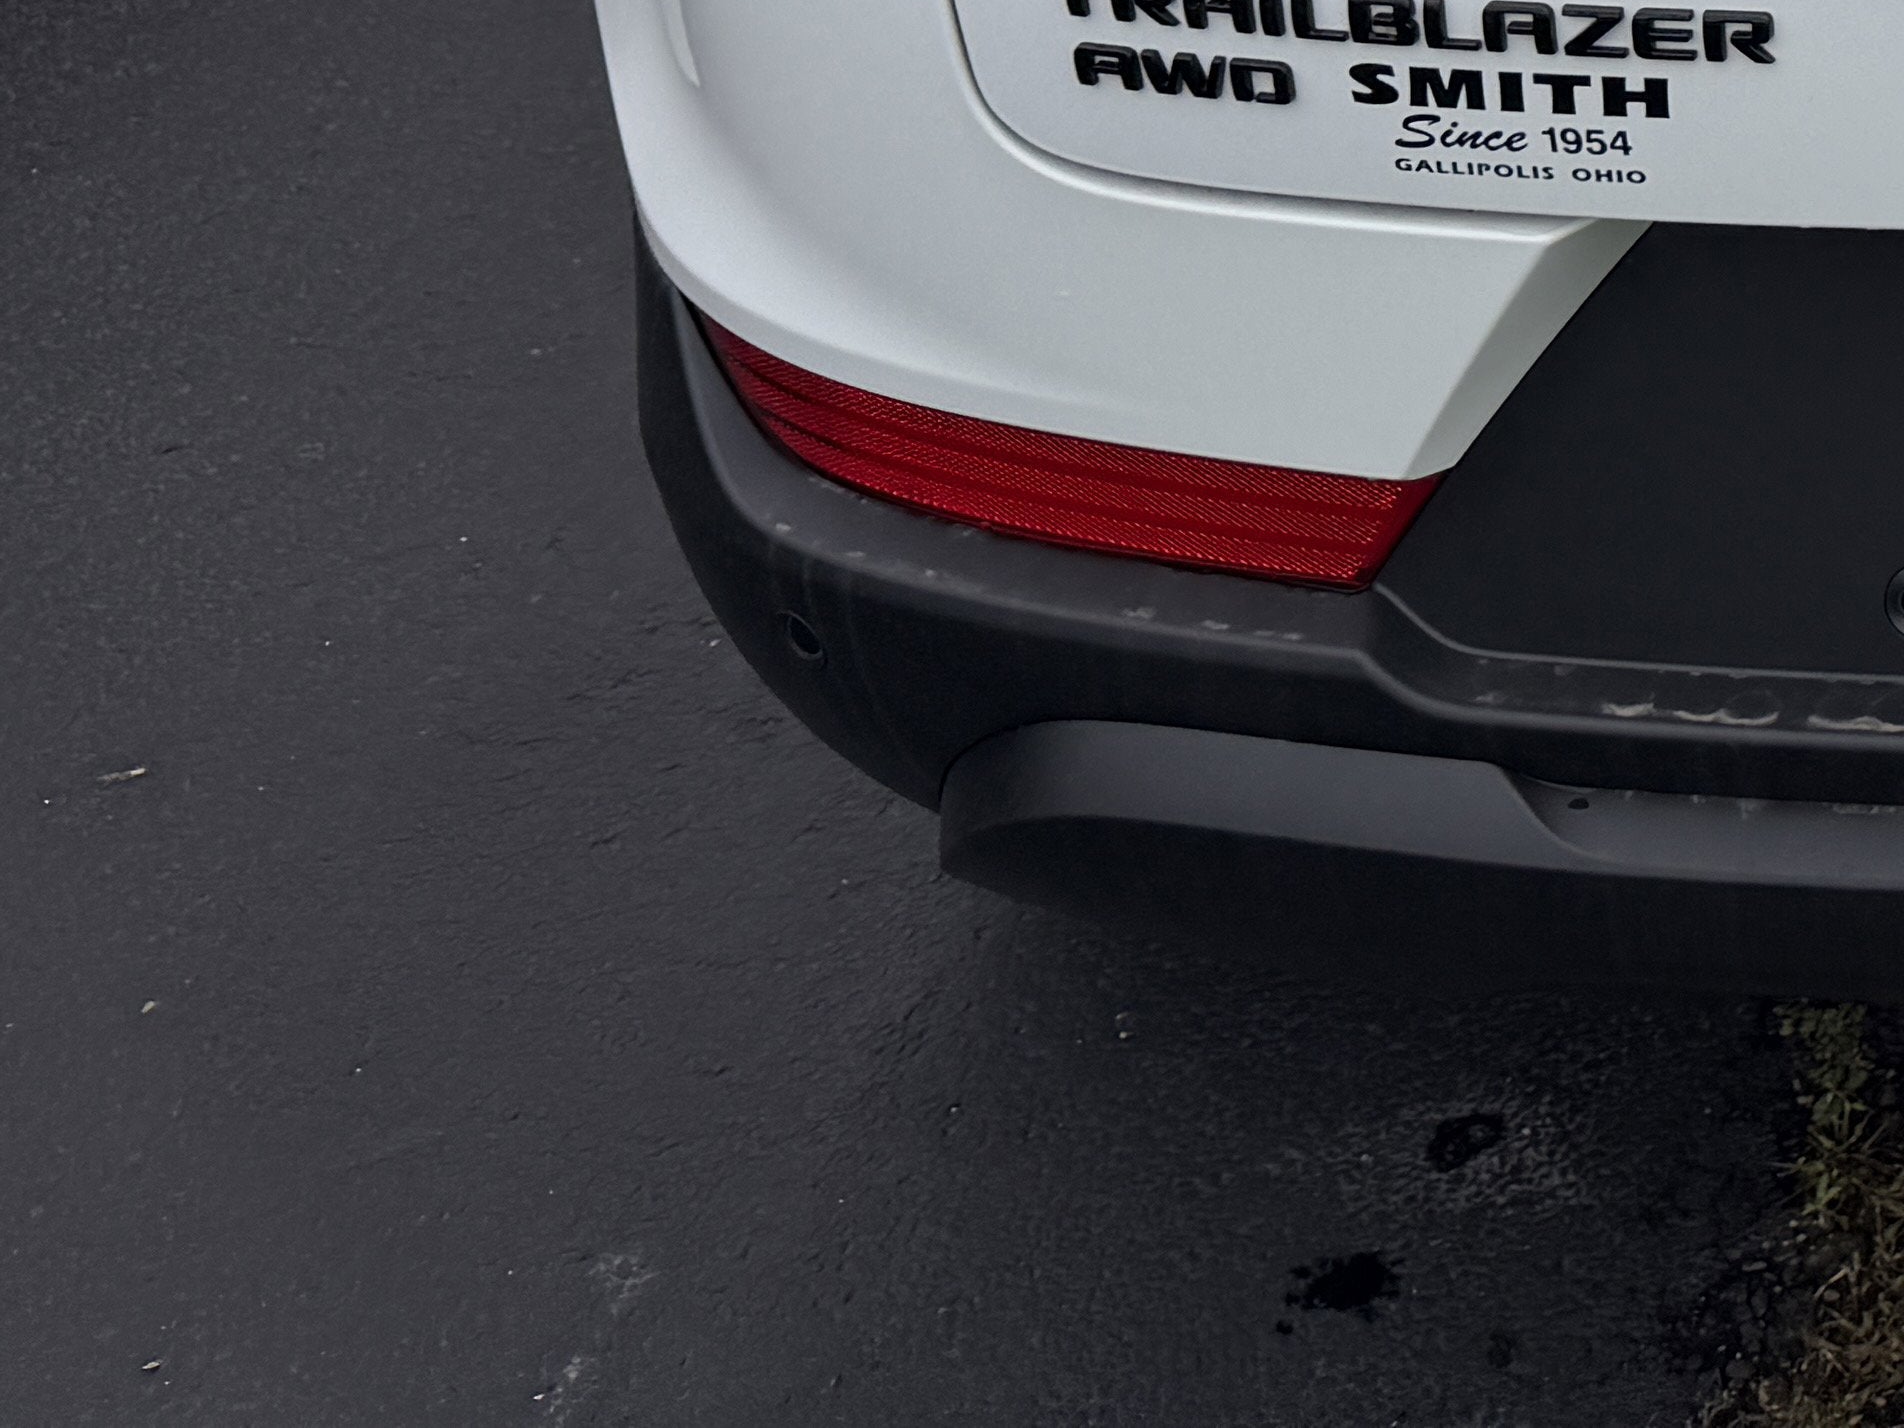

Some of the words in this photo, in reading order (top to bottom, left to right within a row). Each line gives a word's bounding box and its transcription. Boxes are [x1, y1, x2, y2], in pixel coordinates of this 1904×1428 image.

[1073, 40, 1298, 106] AWD
[1347, 62, 1672, 120] SMITH
[1393, 112, 1530, 154] Since
[1540, 125, 1634, 157] 1954
[1393, 157, 1556, 181] GALLIPOLIS
[1570, 167, 1648, 185] OHIO
